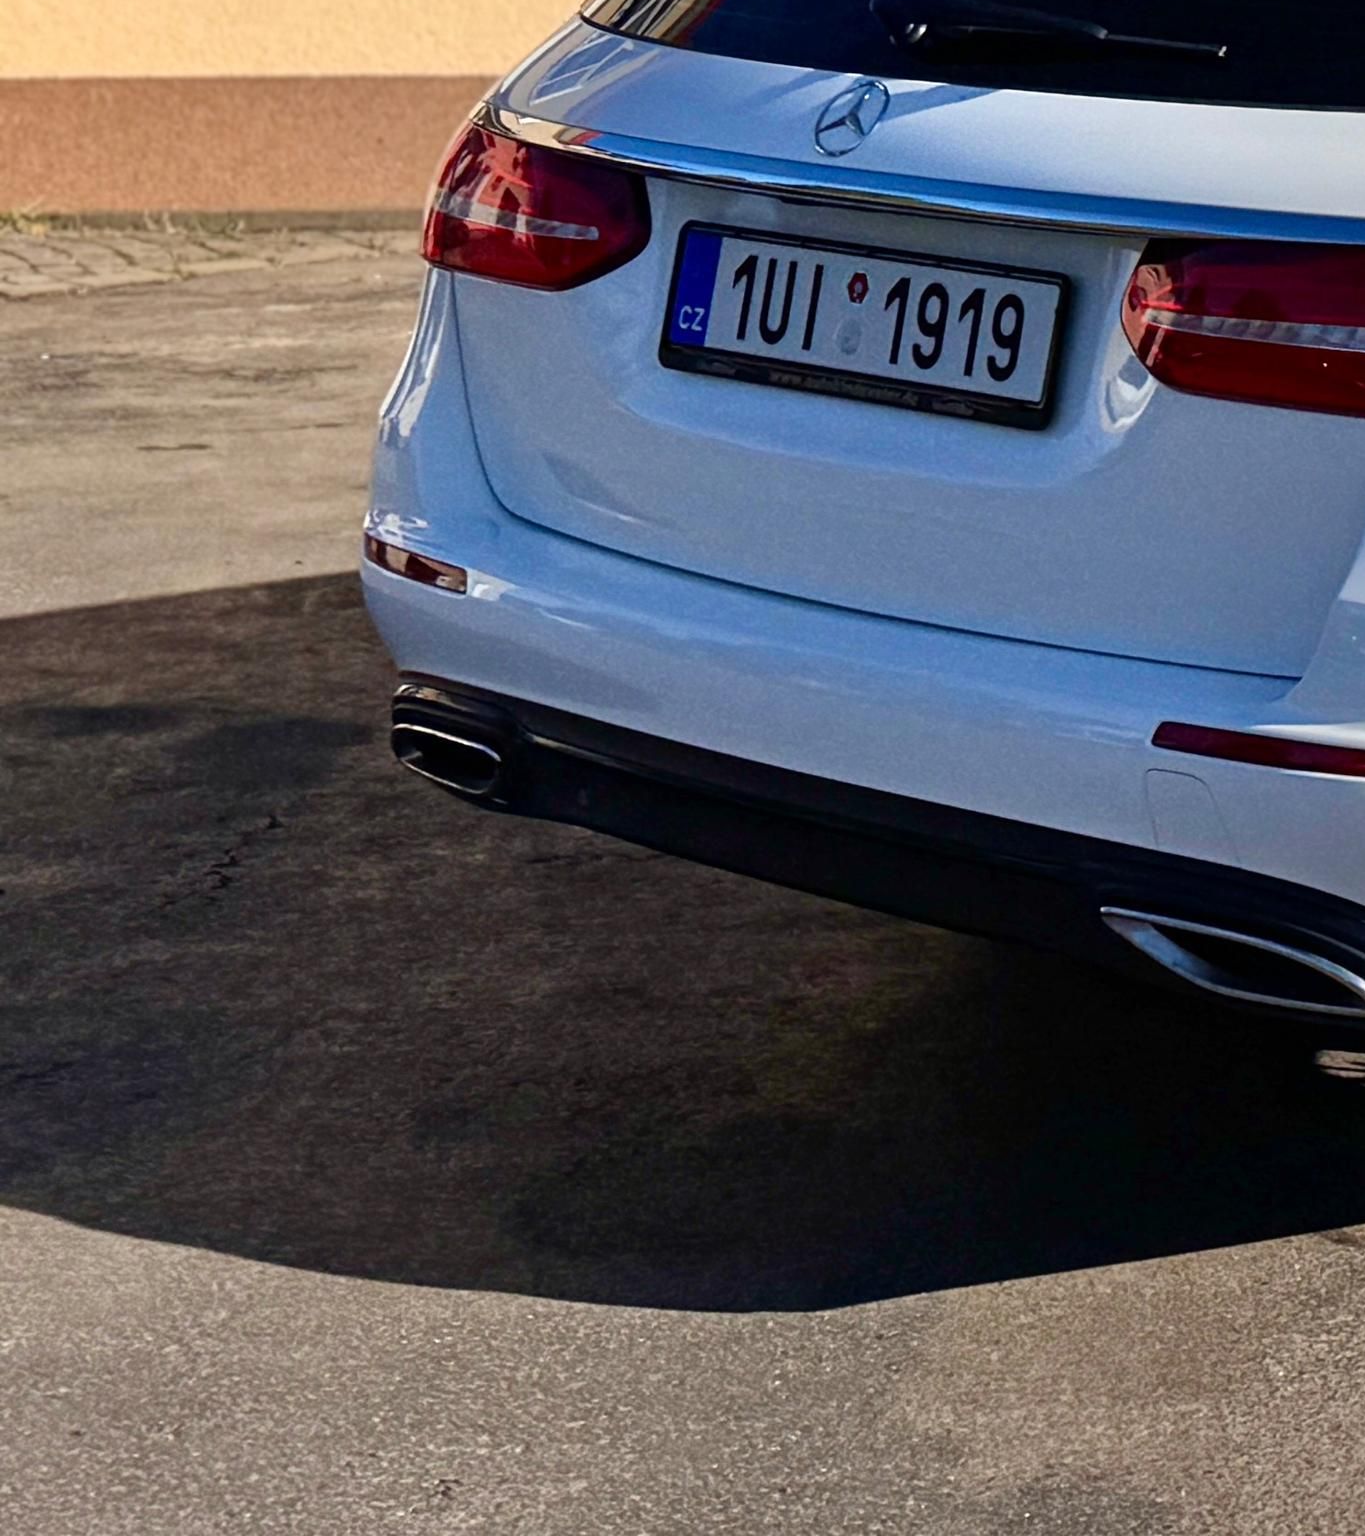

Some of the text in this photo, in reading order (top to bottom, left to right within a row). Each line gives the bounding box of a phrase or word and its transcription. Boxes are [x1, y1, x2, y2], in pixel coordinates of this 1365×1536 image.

[678, 305, 705, 331] CZ
[732, 254, 1025, 382] 1UI 1919
